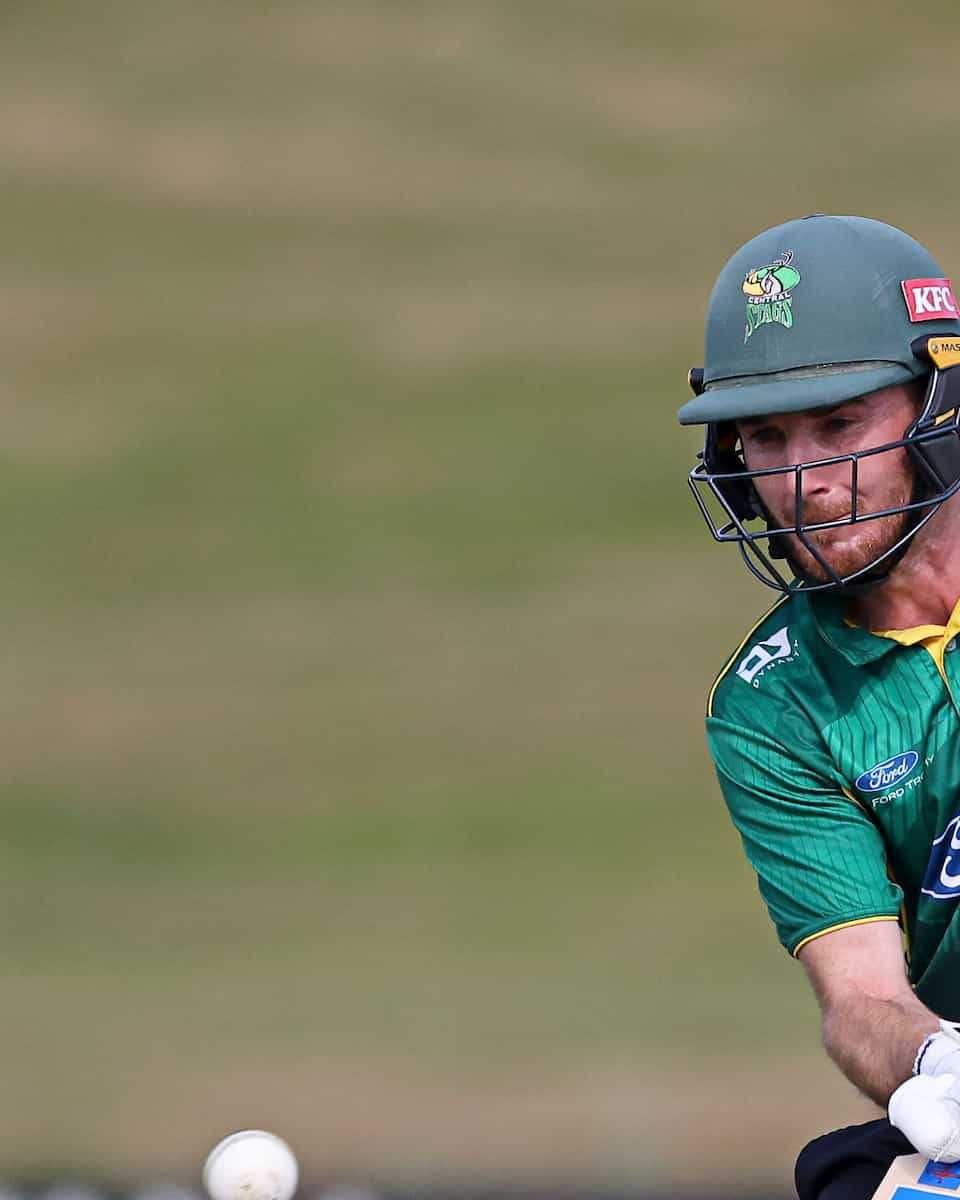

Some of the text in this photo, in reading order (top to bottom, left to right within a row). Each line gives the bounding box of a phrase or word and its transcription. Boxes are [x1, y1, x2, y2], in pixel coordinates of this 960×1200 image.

[748, 292, 792, 304] CENTRAL
[912, 286, 956, 314] KFC
[744, 298, 793, 344] STAGS
[870, 757, 909, 789] Ford
[871, 788, 905, 808] FORD
